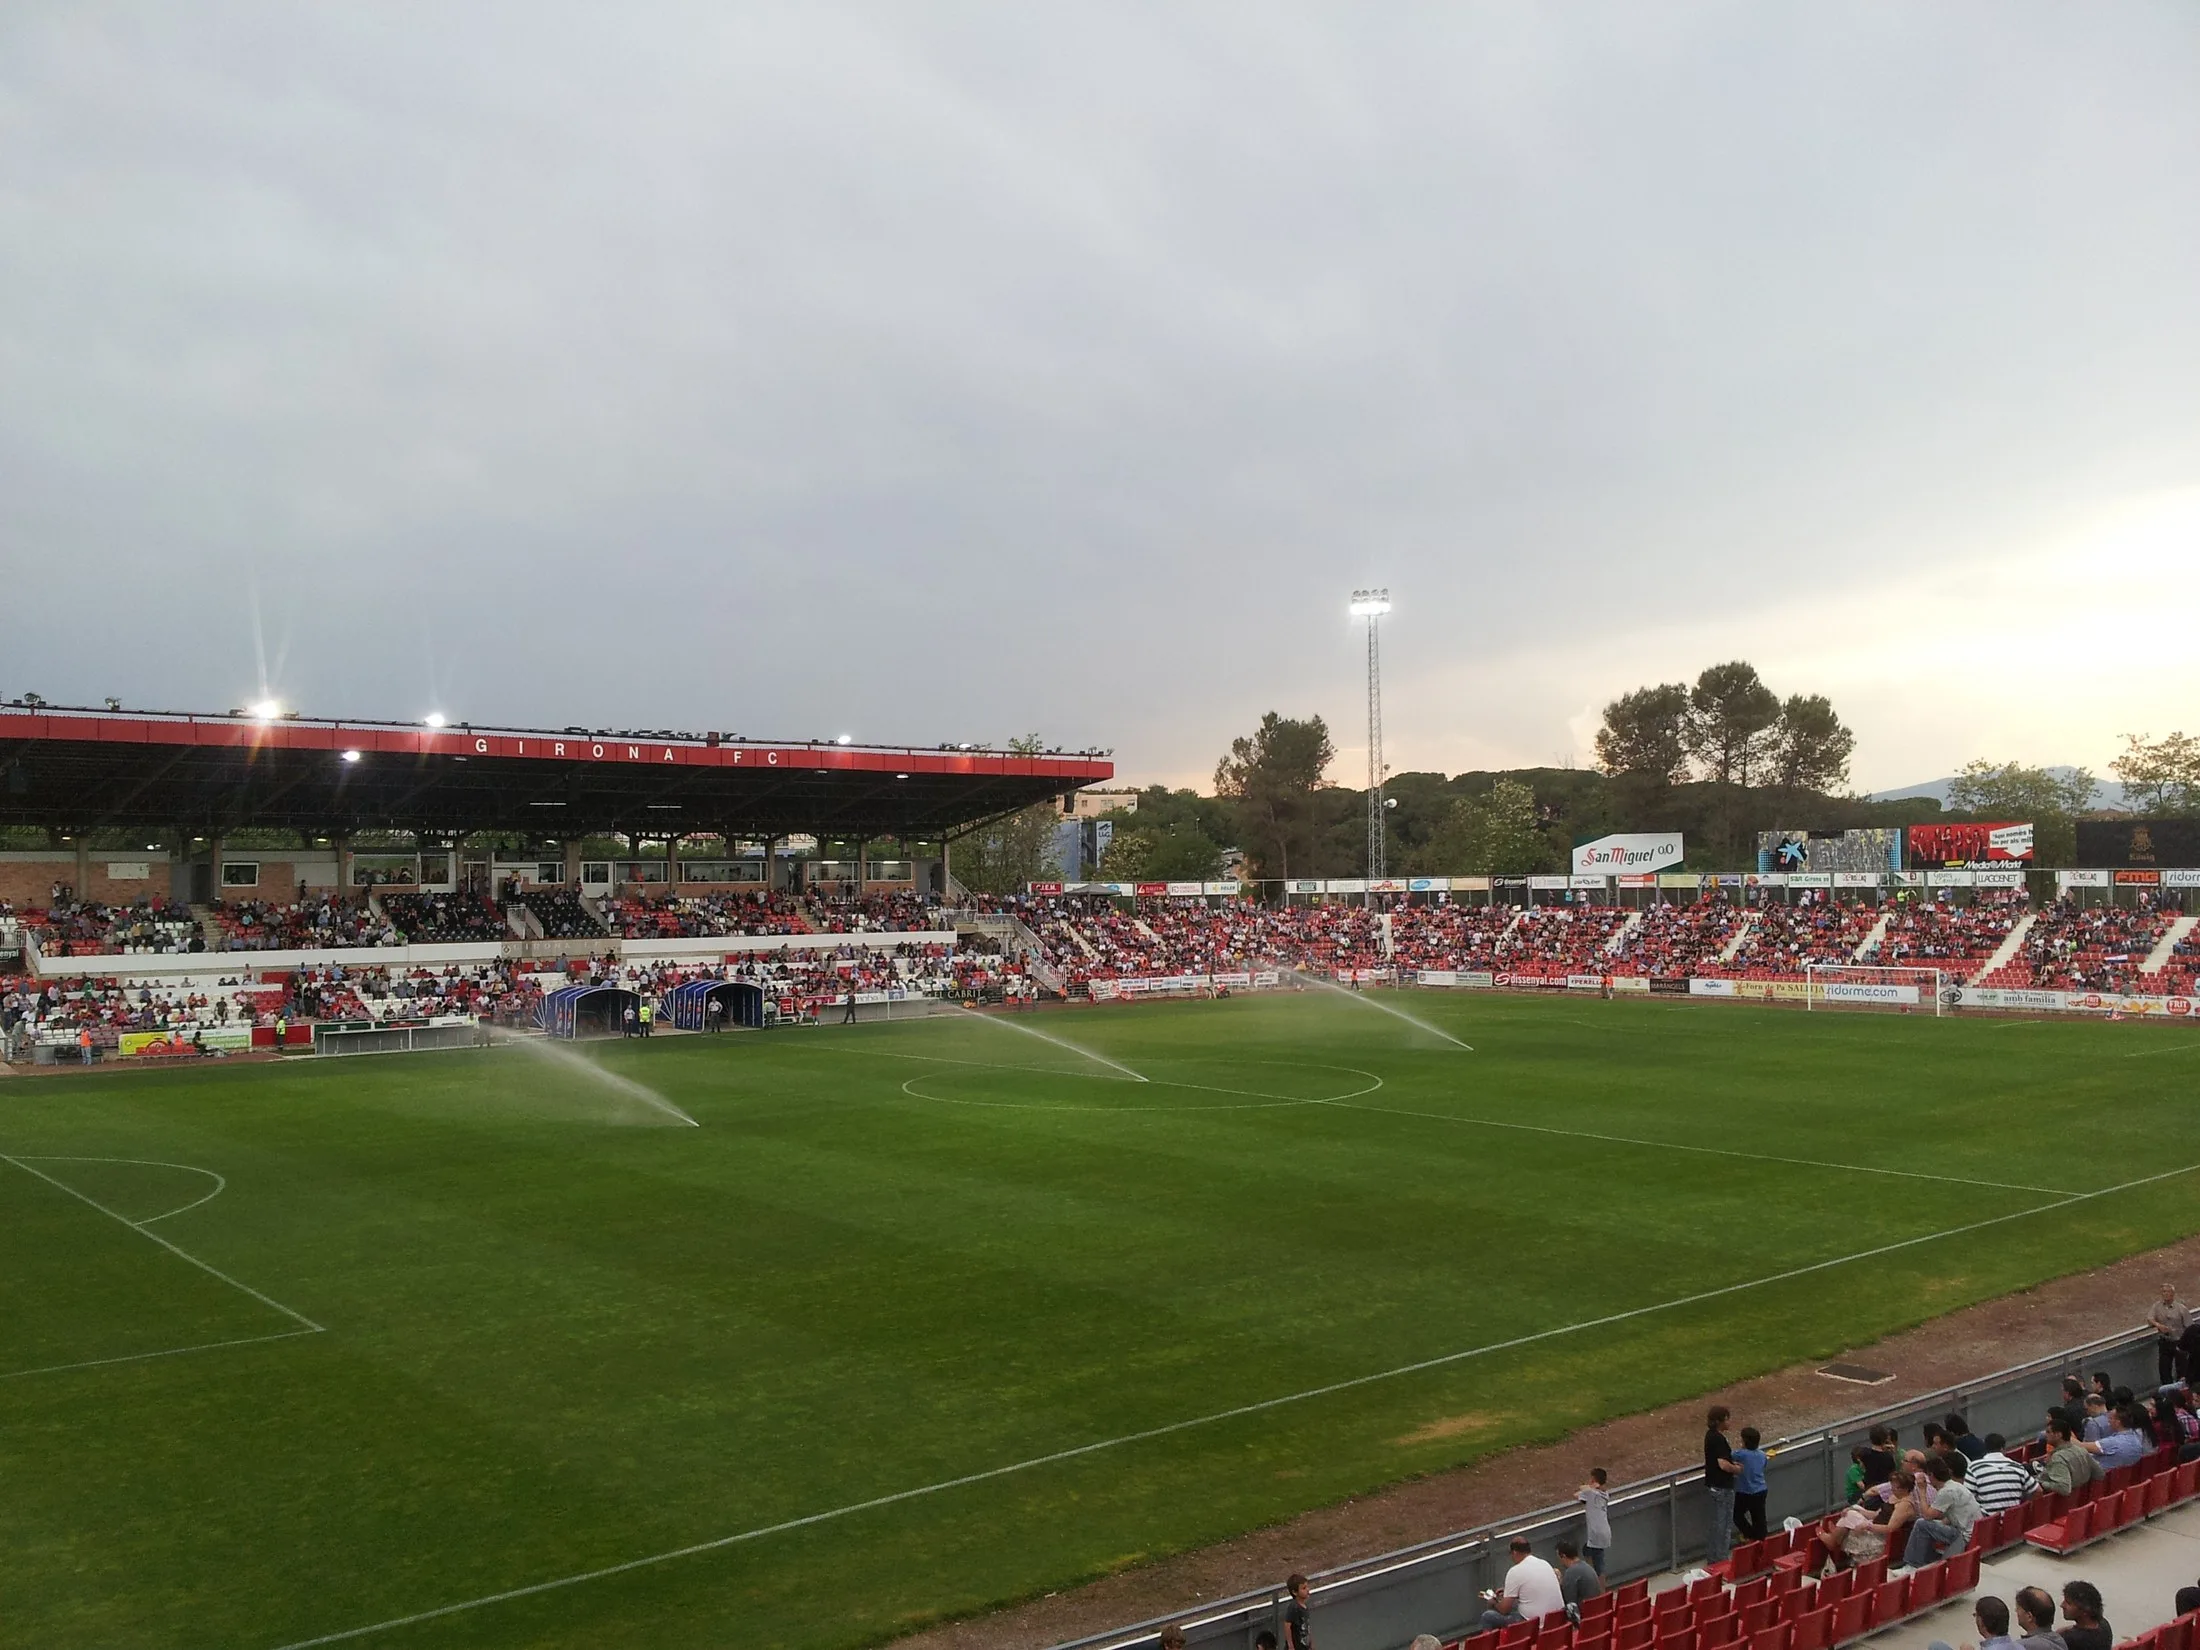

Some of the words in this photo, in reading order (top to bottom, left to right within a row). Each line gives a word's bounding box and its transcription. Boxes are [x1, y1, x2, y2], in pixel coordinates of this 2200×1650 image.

[475, 738, 673, 761] GIRONA
[732, 751, 778, 765] FC
[1511, 973, 1567, 986] dissenyal.com
[947, 989, 981, 999] CABRIT
[2169, 1000, 2187, 1008] FRIT
